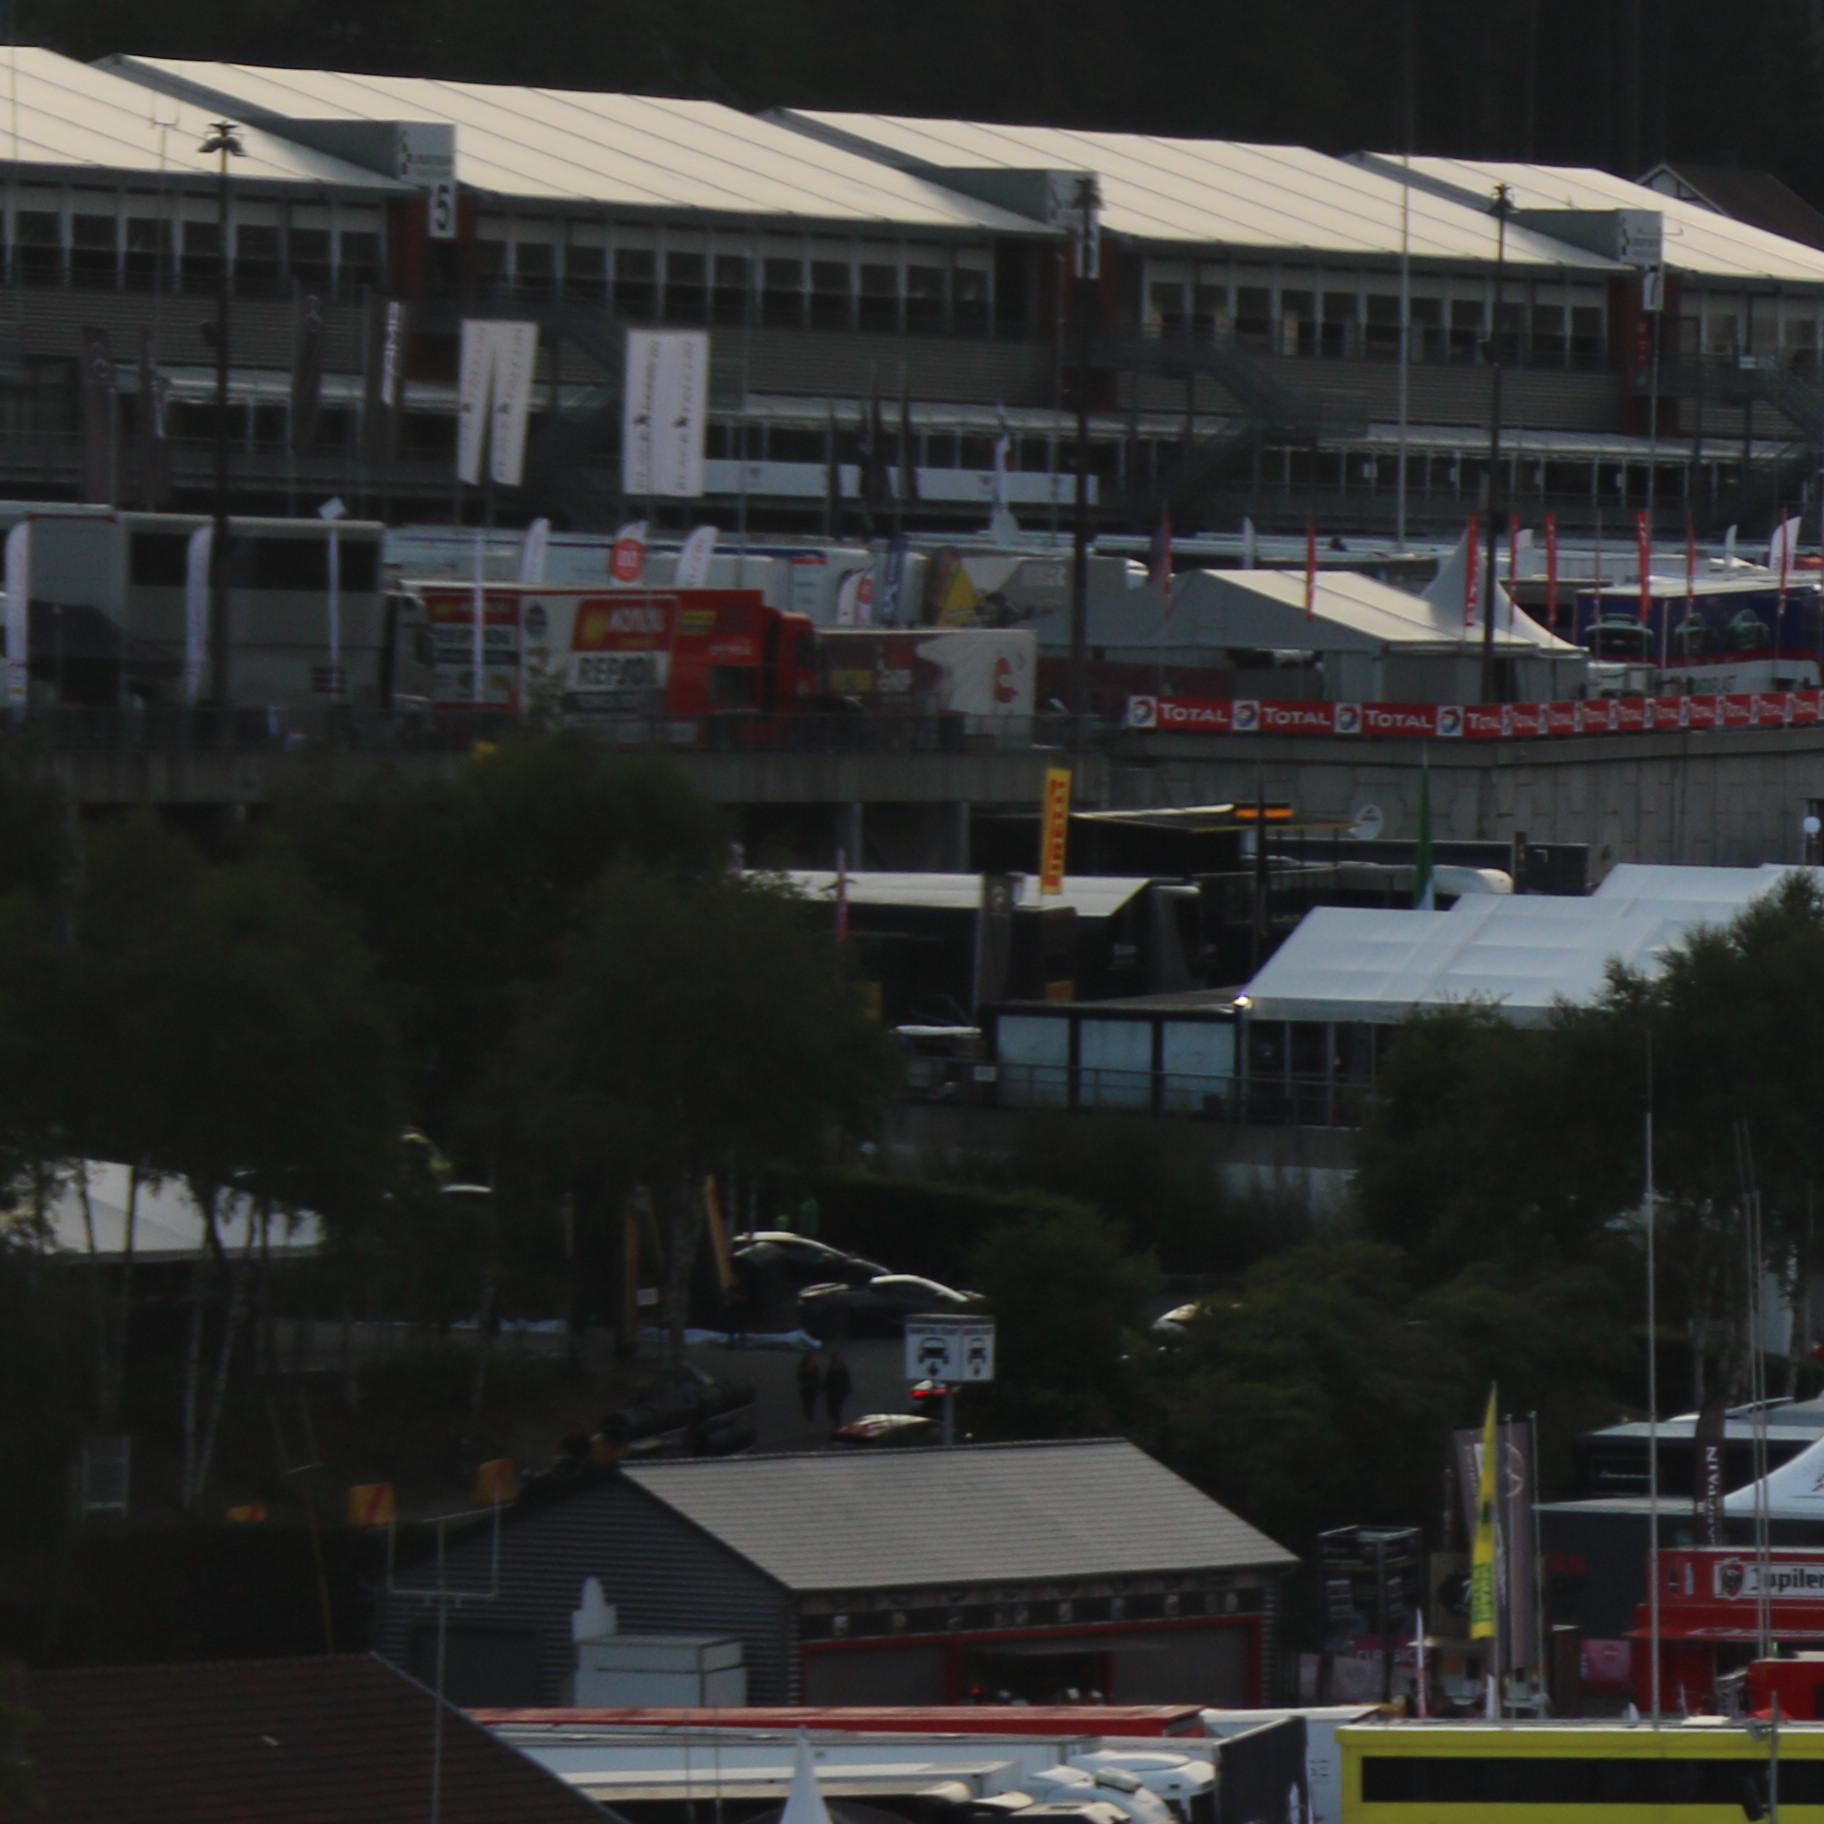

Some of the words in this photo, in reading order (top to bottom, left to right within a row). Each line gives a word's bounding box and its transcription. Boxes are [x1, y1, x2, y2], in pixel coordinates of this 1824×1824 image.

[1158, 702, 1229, 724] TOTAL
[1262, 706, 1332, 727] TOTAL
[1364, 709, 1433, 730] TOTAL
